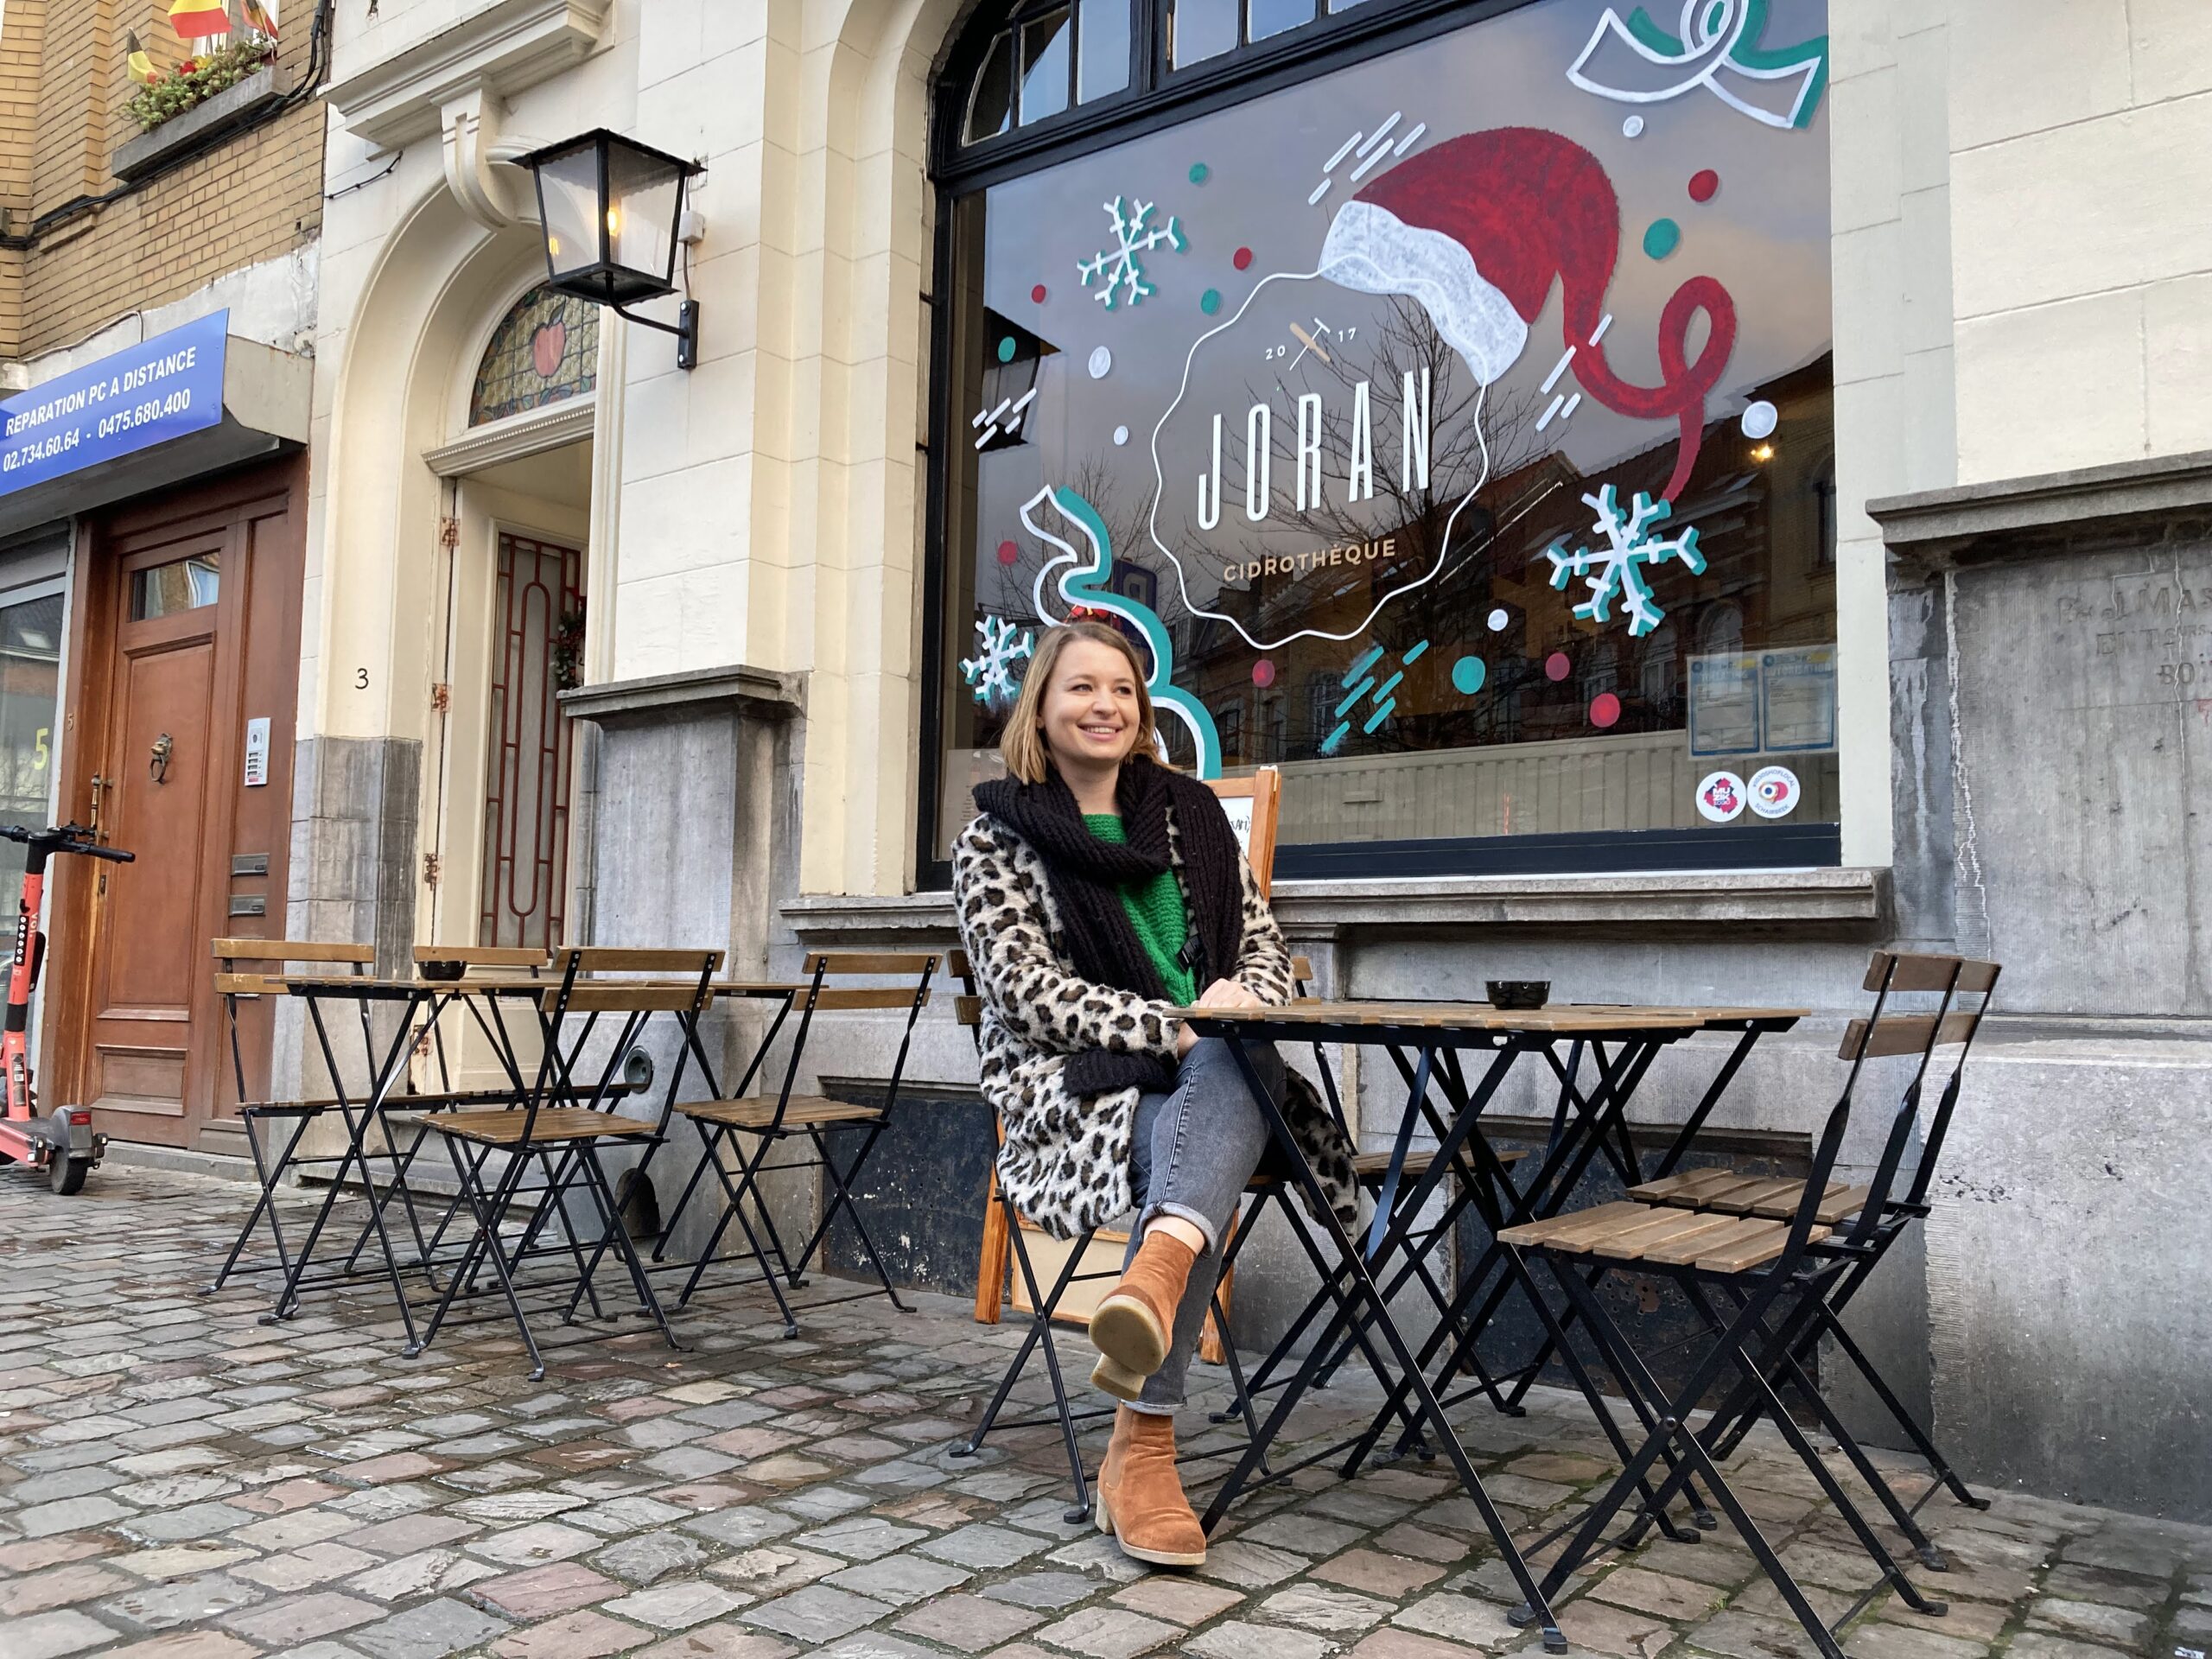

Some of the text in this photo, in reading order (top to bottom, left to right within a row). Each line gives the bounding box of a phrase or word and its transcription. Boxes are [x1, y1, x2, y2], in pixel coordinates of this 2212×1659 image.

[1265, 327, 1357, 361] 20 17
[5, 346, 197, 437] REPARATION PC A DISTANCE
[3, 428, 79, 473] 02.734.60.64
[98, 388, 191, 440] 0475.680.400
[1198, 366, 1430, 531] JORAN
[355, 668, 369, 690] 3
[34, 728, 49, 770] 5
